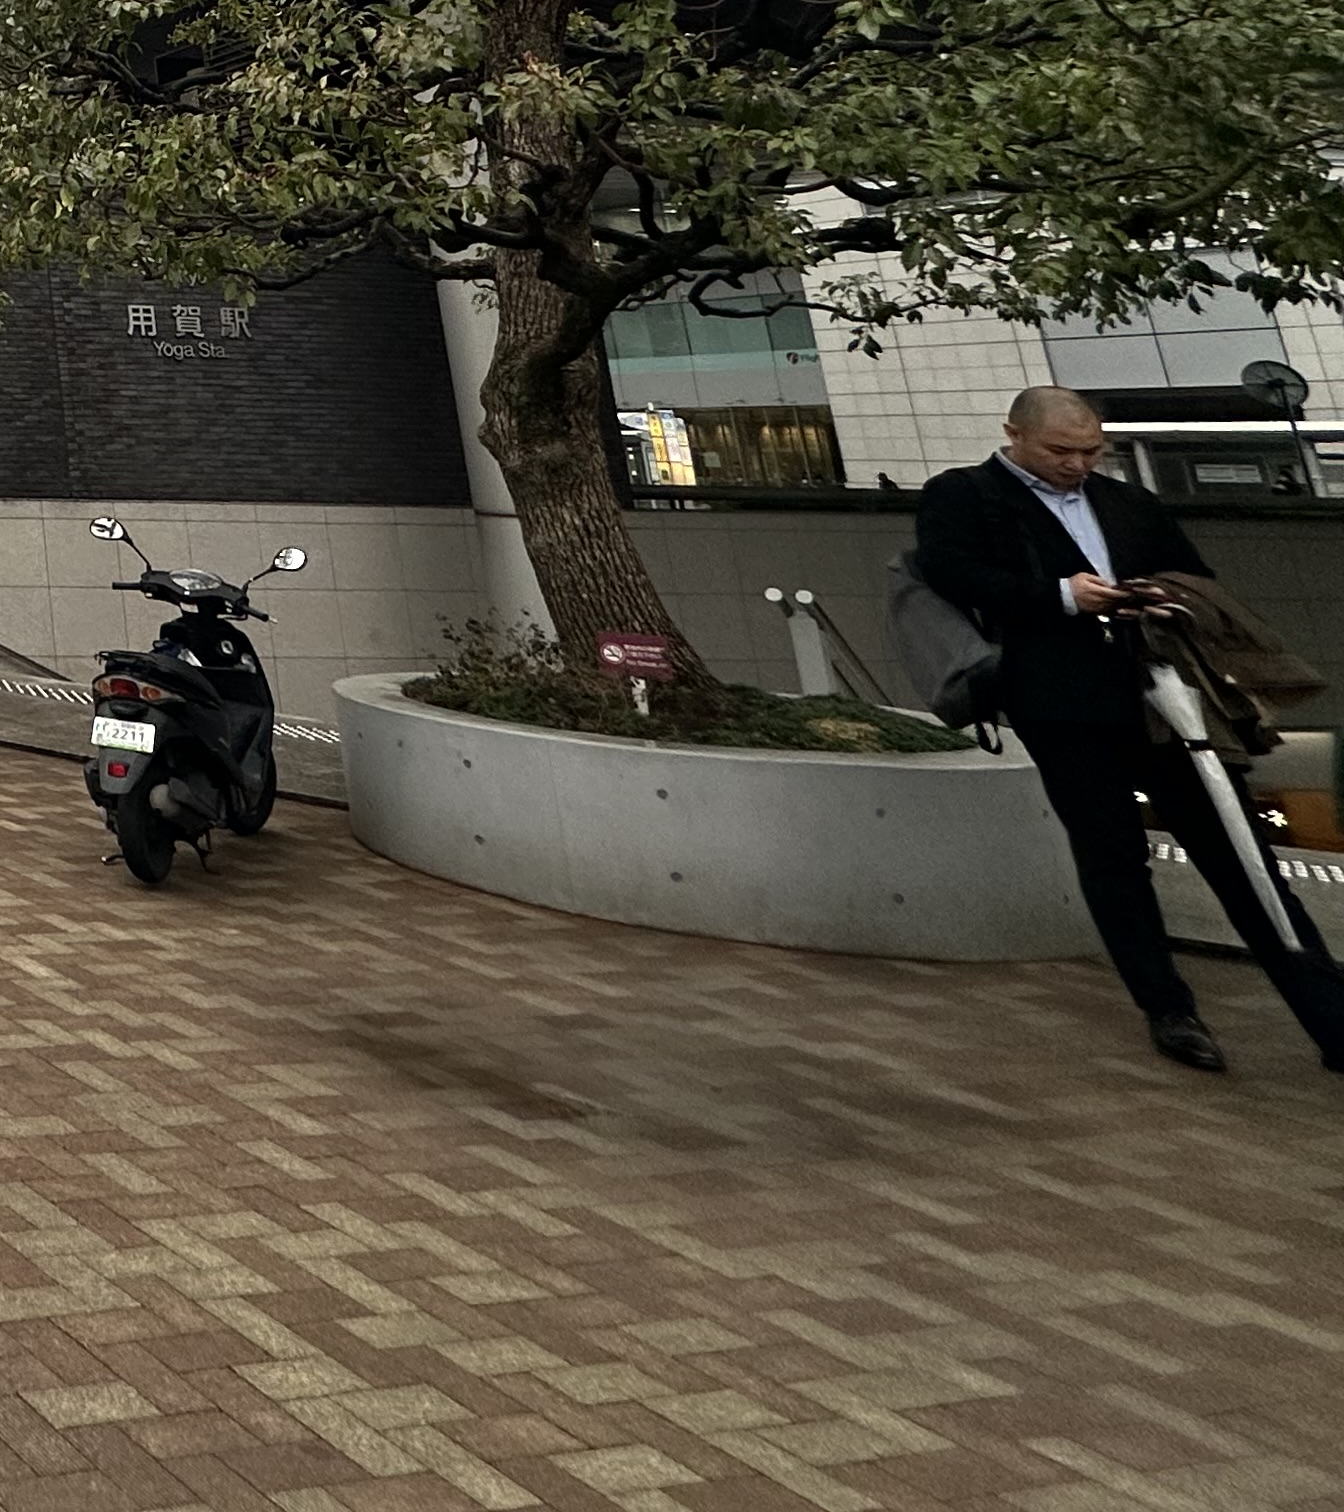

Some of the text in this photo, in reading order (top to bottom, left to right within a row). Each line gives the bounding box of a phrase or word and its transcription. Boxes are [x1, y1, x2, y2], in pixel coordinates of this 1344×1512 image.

[127, 303, 252, 339] 用賀駅
[153, 340, 196, 361] Yoga
[111, 728, 145, 743] 2211
